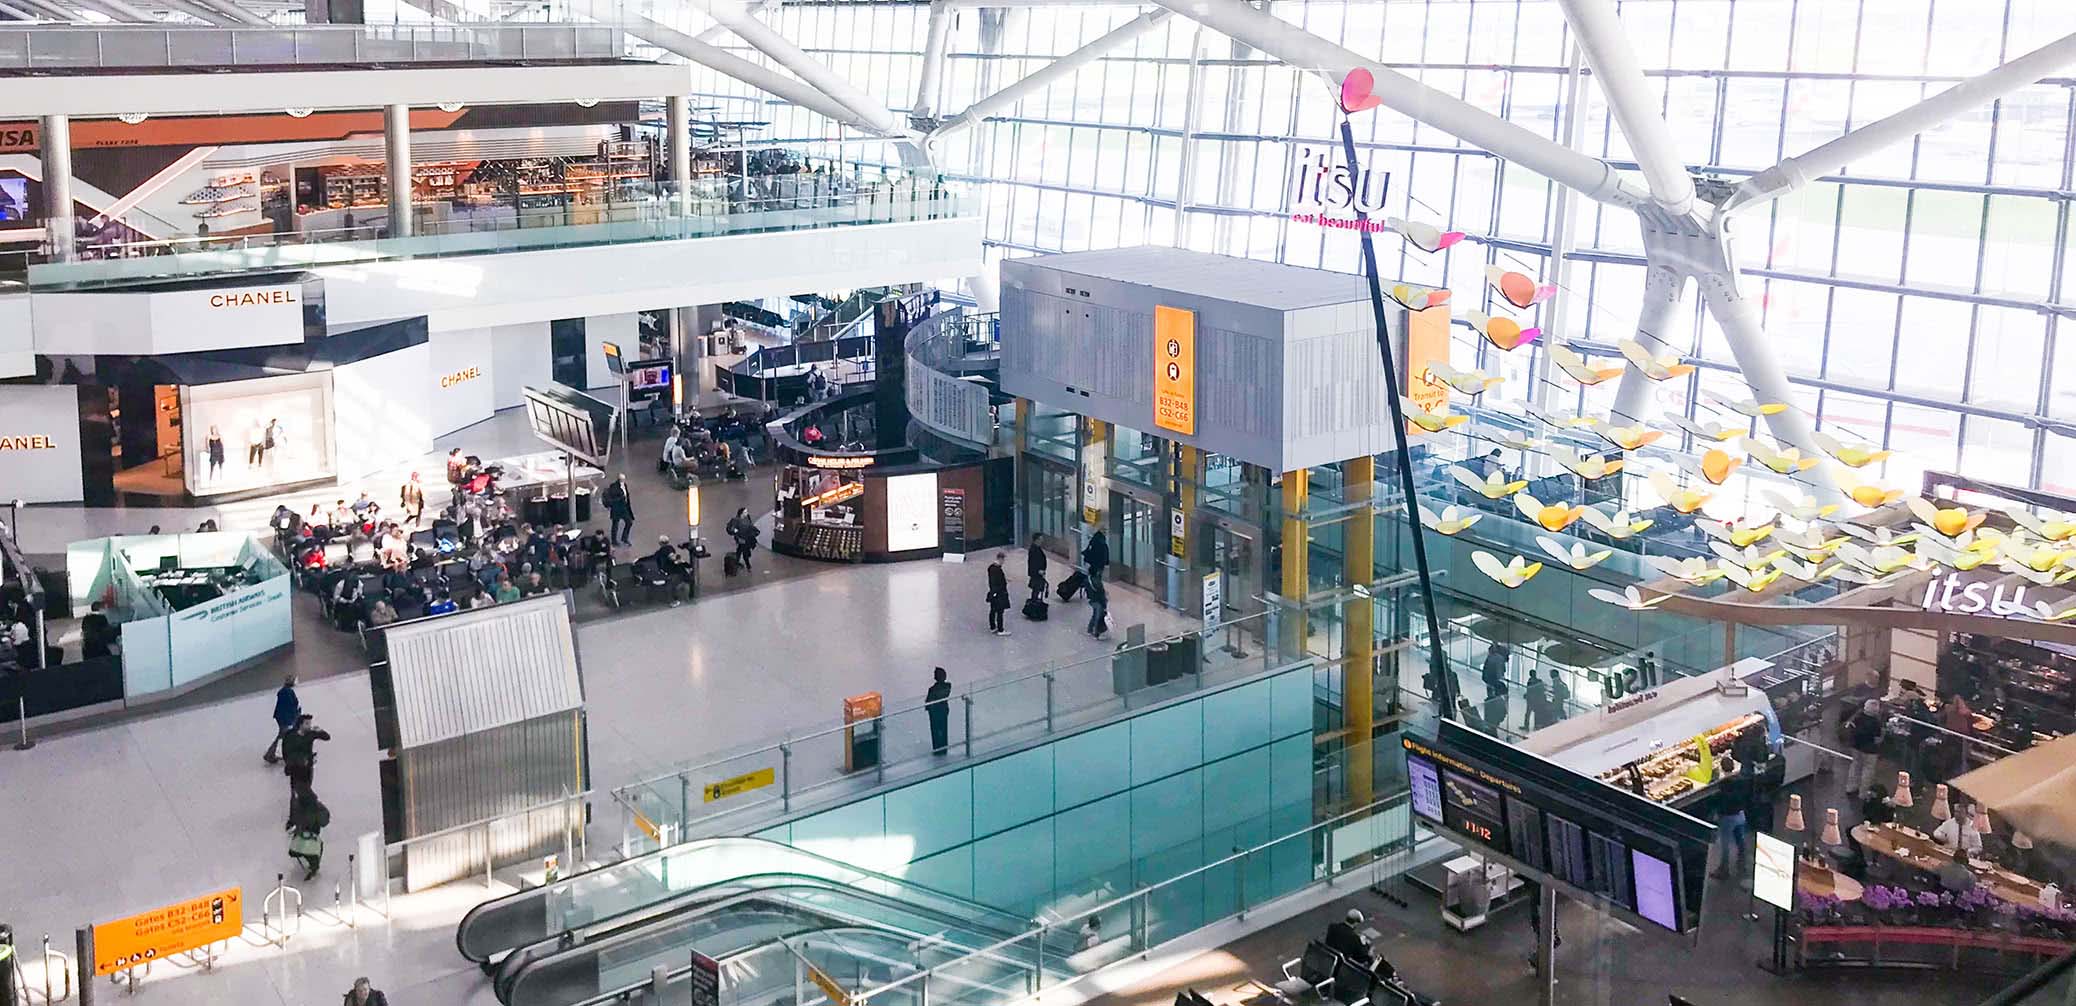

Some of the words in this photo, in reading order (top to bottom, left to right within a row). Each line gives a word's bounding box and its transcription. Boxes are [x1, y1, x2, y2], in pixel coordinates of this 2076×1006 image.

[1295, 147, 1391, 214] itsu
[1292, 213, 1314, 224] eat
[1319, 213, 1385, 233] beautiful
[210, 291, 296, 307] CHANEL
[441, 366, 481, 388] CHANEL
[1159, 396, 1189, 411] B32-B48
[1159, 407, 1189, 422] C52-C66
[1922, 566, 2026, 616] itsu
[210, 599, 238, 613] BRITISH
[1412, 742, 1432, 756] Flight
[1432, 750, 1475, 774] Information
[1479, 770, 1522, 794] Departures
[1464, 820, 1492, 840] 11:12
